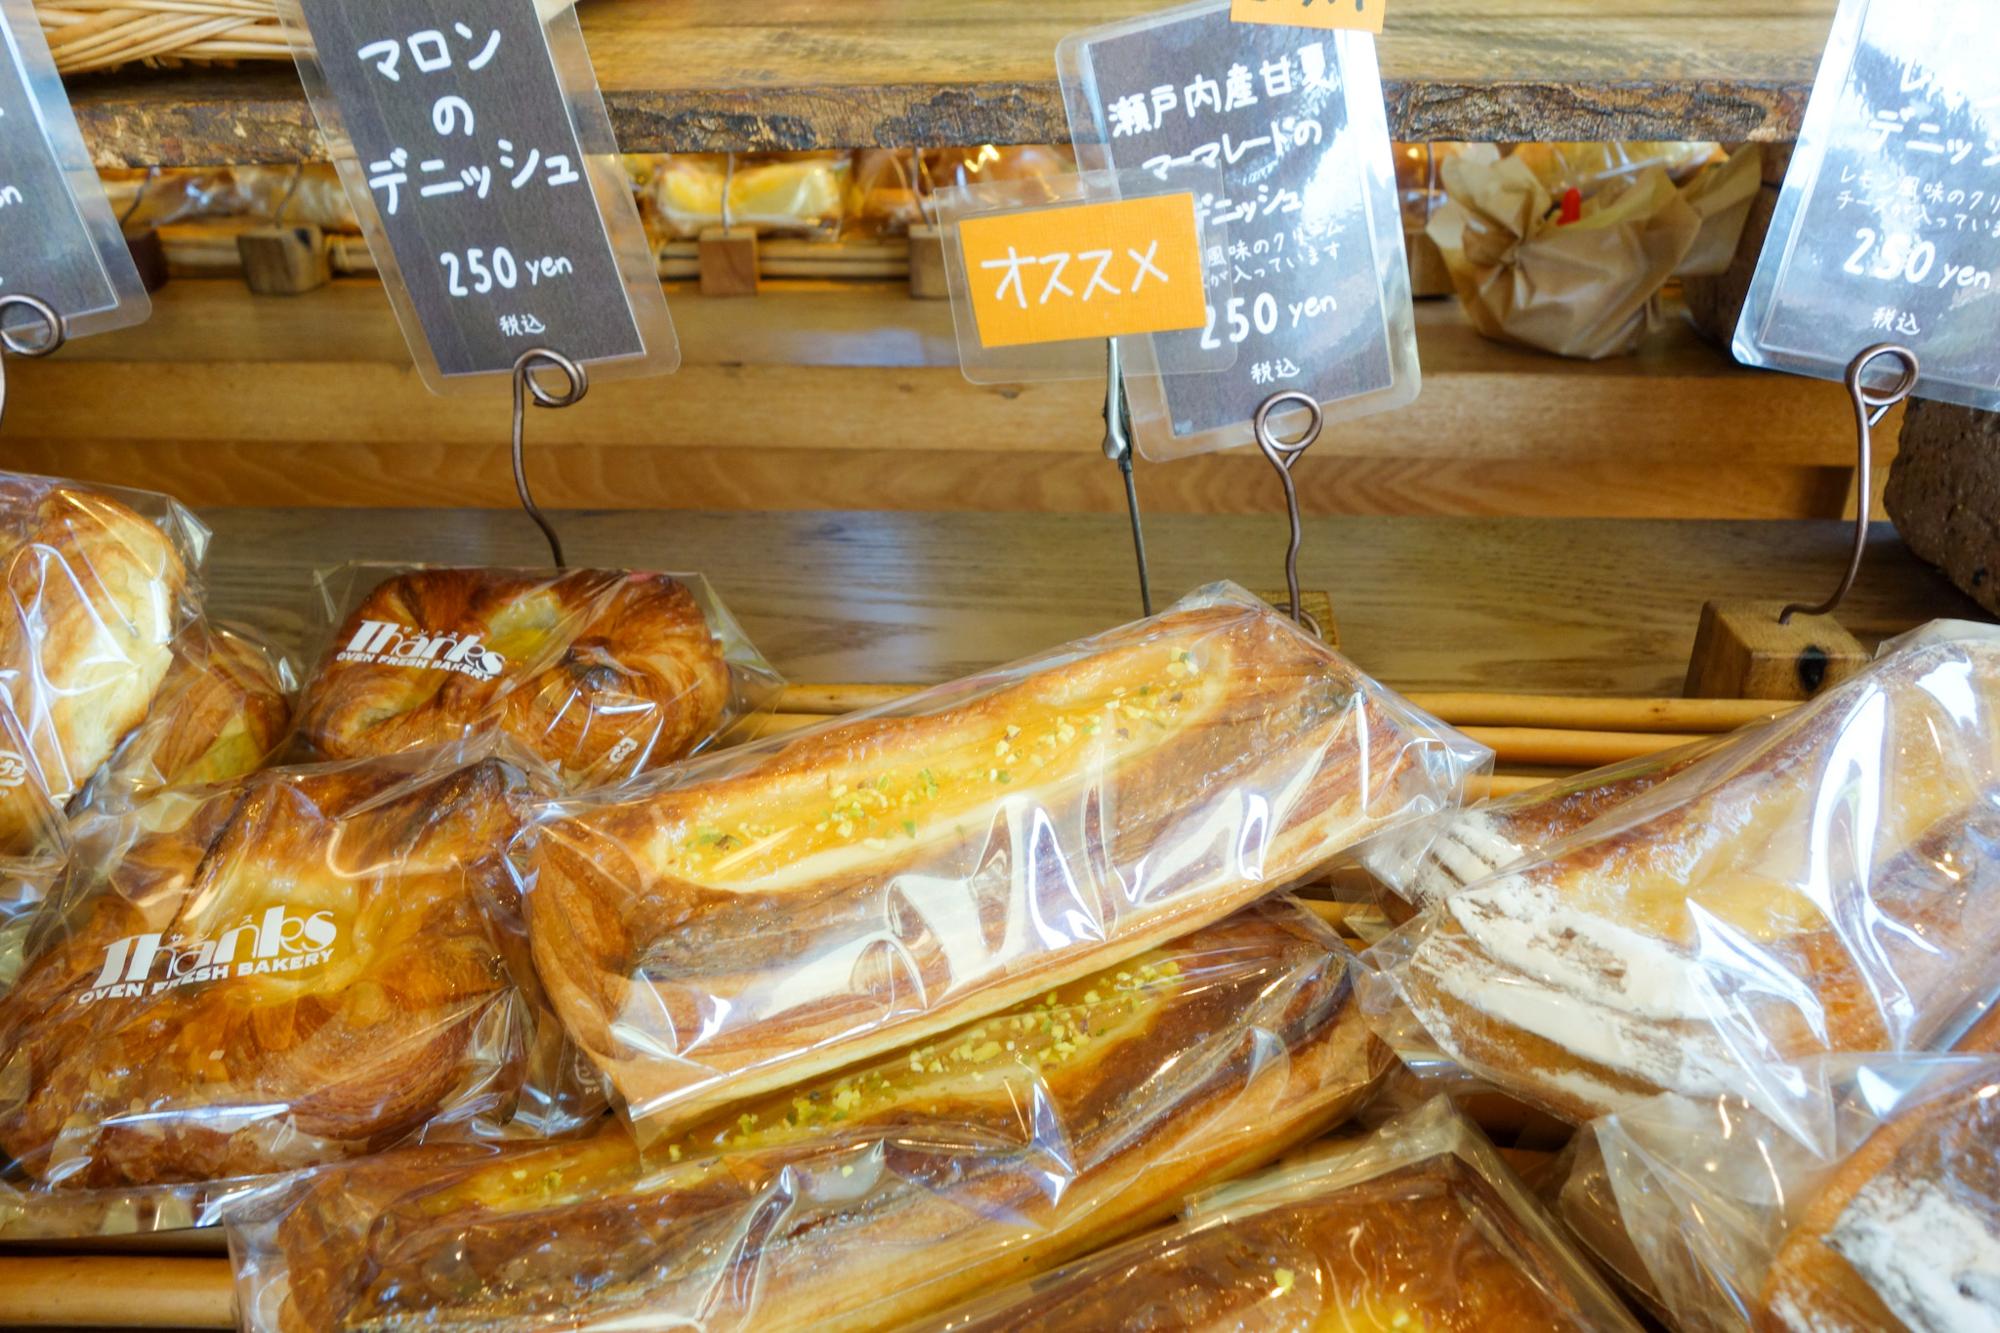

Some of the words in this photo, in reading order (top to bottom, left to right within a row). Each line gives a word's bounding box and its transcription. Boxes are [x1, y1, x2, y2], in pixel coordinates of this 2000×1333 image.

[358, 22, 500, 81] マロン
[432, 95, 475, 136] の
[369, 139, 579, 215] デニッシュ
[1142, 118, 1323, 181] マーマレードの
[440, 246, 517, 297] 250
[525, 256, 573, 284] yen
[981, 240, 1169, 309] オススメ
[1843, 227, 1937, 283] 250
[1938, 263, 1992, 289] yen
[499, 313, 546, 336] 税込
[1200, 291, 1278, 350] 250
[1288, 295, 1337, 328] yen
[1872, 305, 1921, 335] 税込
[1250, 356, 1301, 384] 税込
[336, 651, 375, 664] OVEN
[377, 653, 429, 670] FRESH
[430, 659, 494, 682] BAKERY
[346, 619, 506, 676] Thanks
[92, 904, 337, 989] Thanks
[78, 983, 145, 1005] OVEN
[151, 964, 230, 995] FRESH
[236, 948, 335, 977] BAKERY
